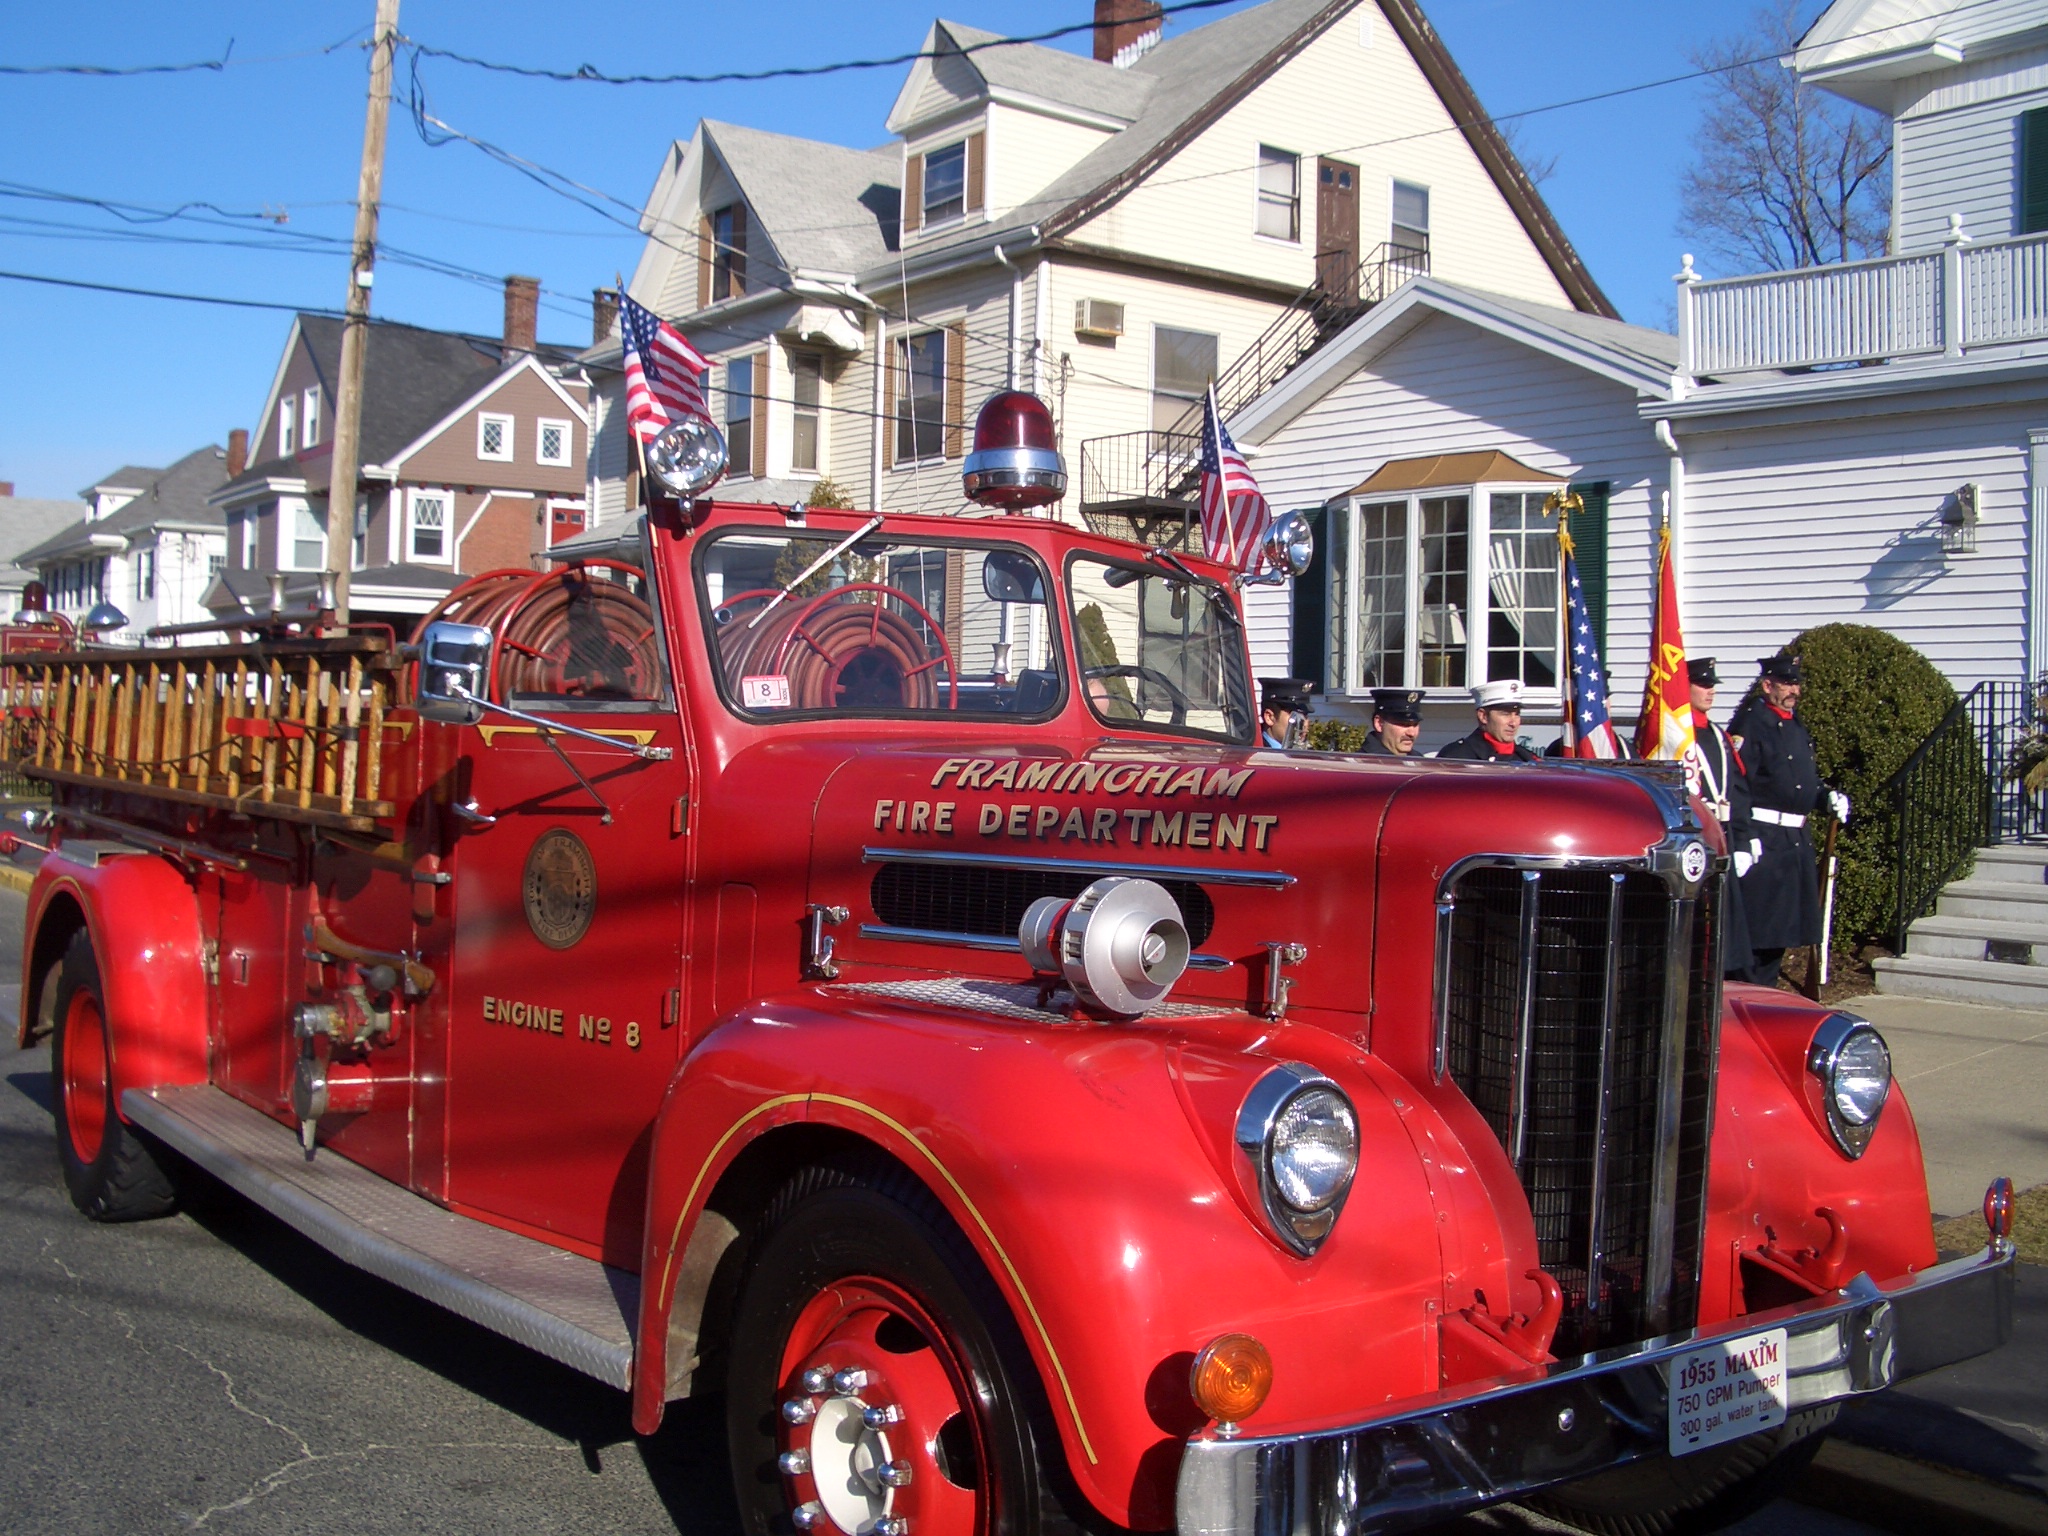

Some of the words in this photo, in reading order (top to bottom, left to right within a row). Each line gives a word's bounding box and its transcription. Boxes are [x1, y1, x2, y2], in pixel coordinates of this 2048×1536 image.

[761, 683, 771, 697] 8
[930, 758, 1255, 797] FRAMINGHAM
[873, 799, 957, 832] FIRE
[978, 803, 1278, 849] DEPARTMENT
[483, 995, 564, 1034] ENGINE
[626, 1021, 640, 1047] 8
[1680, 1359, 1716, 1390] 1955
[1725, 1342, 1779, 1377] MAXIM
[1677, 1392, 1700, 1415] 750
[1706, 1383, 1733, 1407] GPM
[1738, 1373, 1781, 1398] Pumper
[1680, 1418, 1701, 1437] 300
[1706, 1412, 1723, 1432] gal.
[1727, 1403, 1754, 1421] water
[1758, 1395, 1779, 1412] tank
